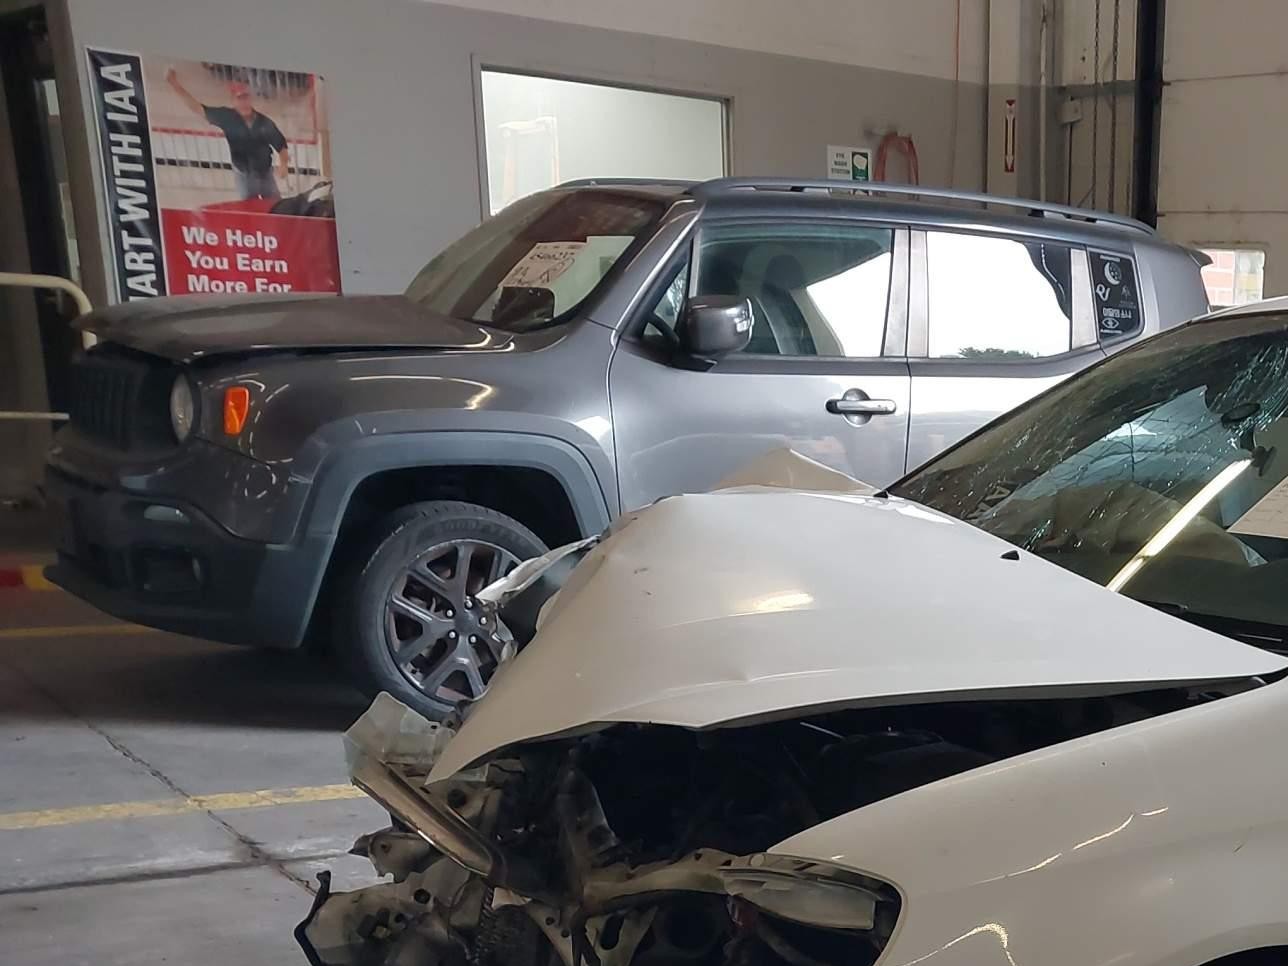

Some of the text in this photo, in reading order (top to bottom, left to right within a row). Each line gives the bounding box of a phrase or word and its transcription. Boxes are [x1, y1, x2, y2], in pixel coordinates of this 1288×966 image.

[100, 62, 159, 302] ART WITH IAA
[182, 225, 278, 252] We Help
[184, 250, 289, 273] You Earn
[187, 274, 292, 294] More For
